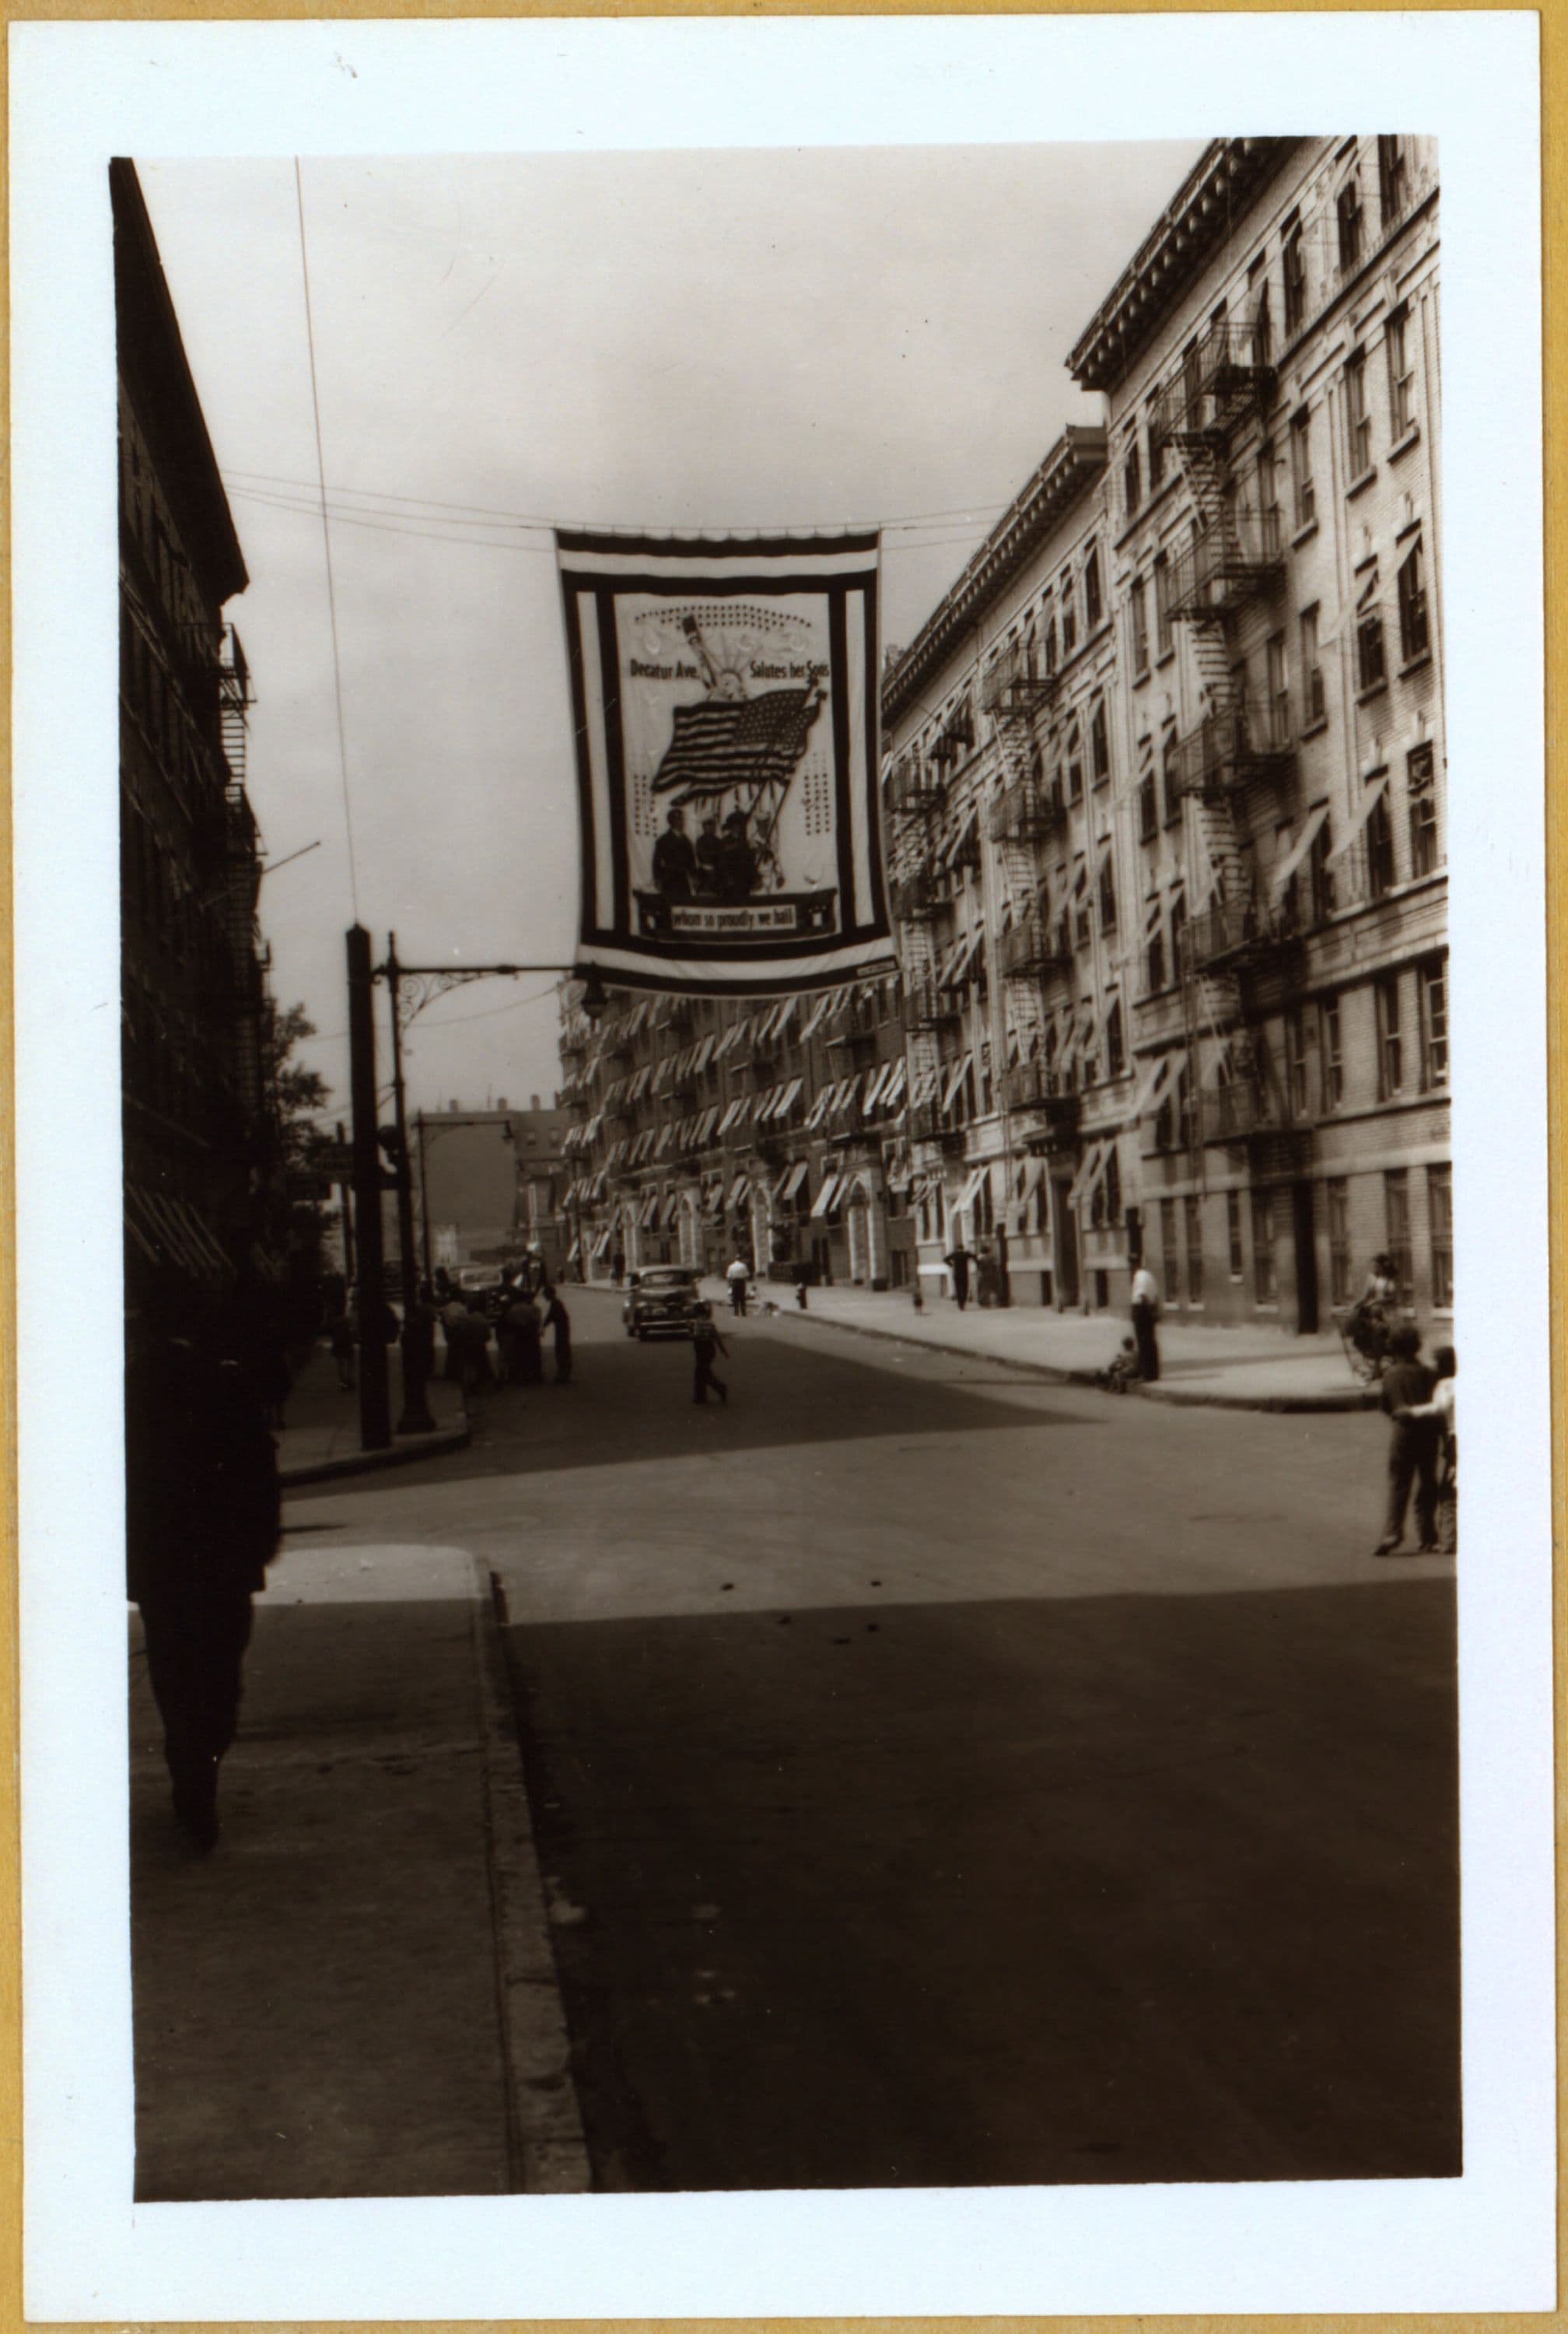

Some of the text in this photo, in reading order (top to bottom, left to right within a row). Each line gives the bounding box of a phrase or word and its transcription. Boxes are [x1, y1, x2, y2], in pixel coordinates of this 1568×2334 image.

[630, 658, 829, 679] Decatur Ave. Salutes her Sons
